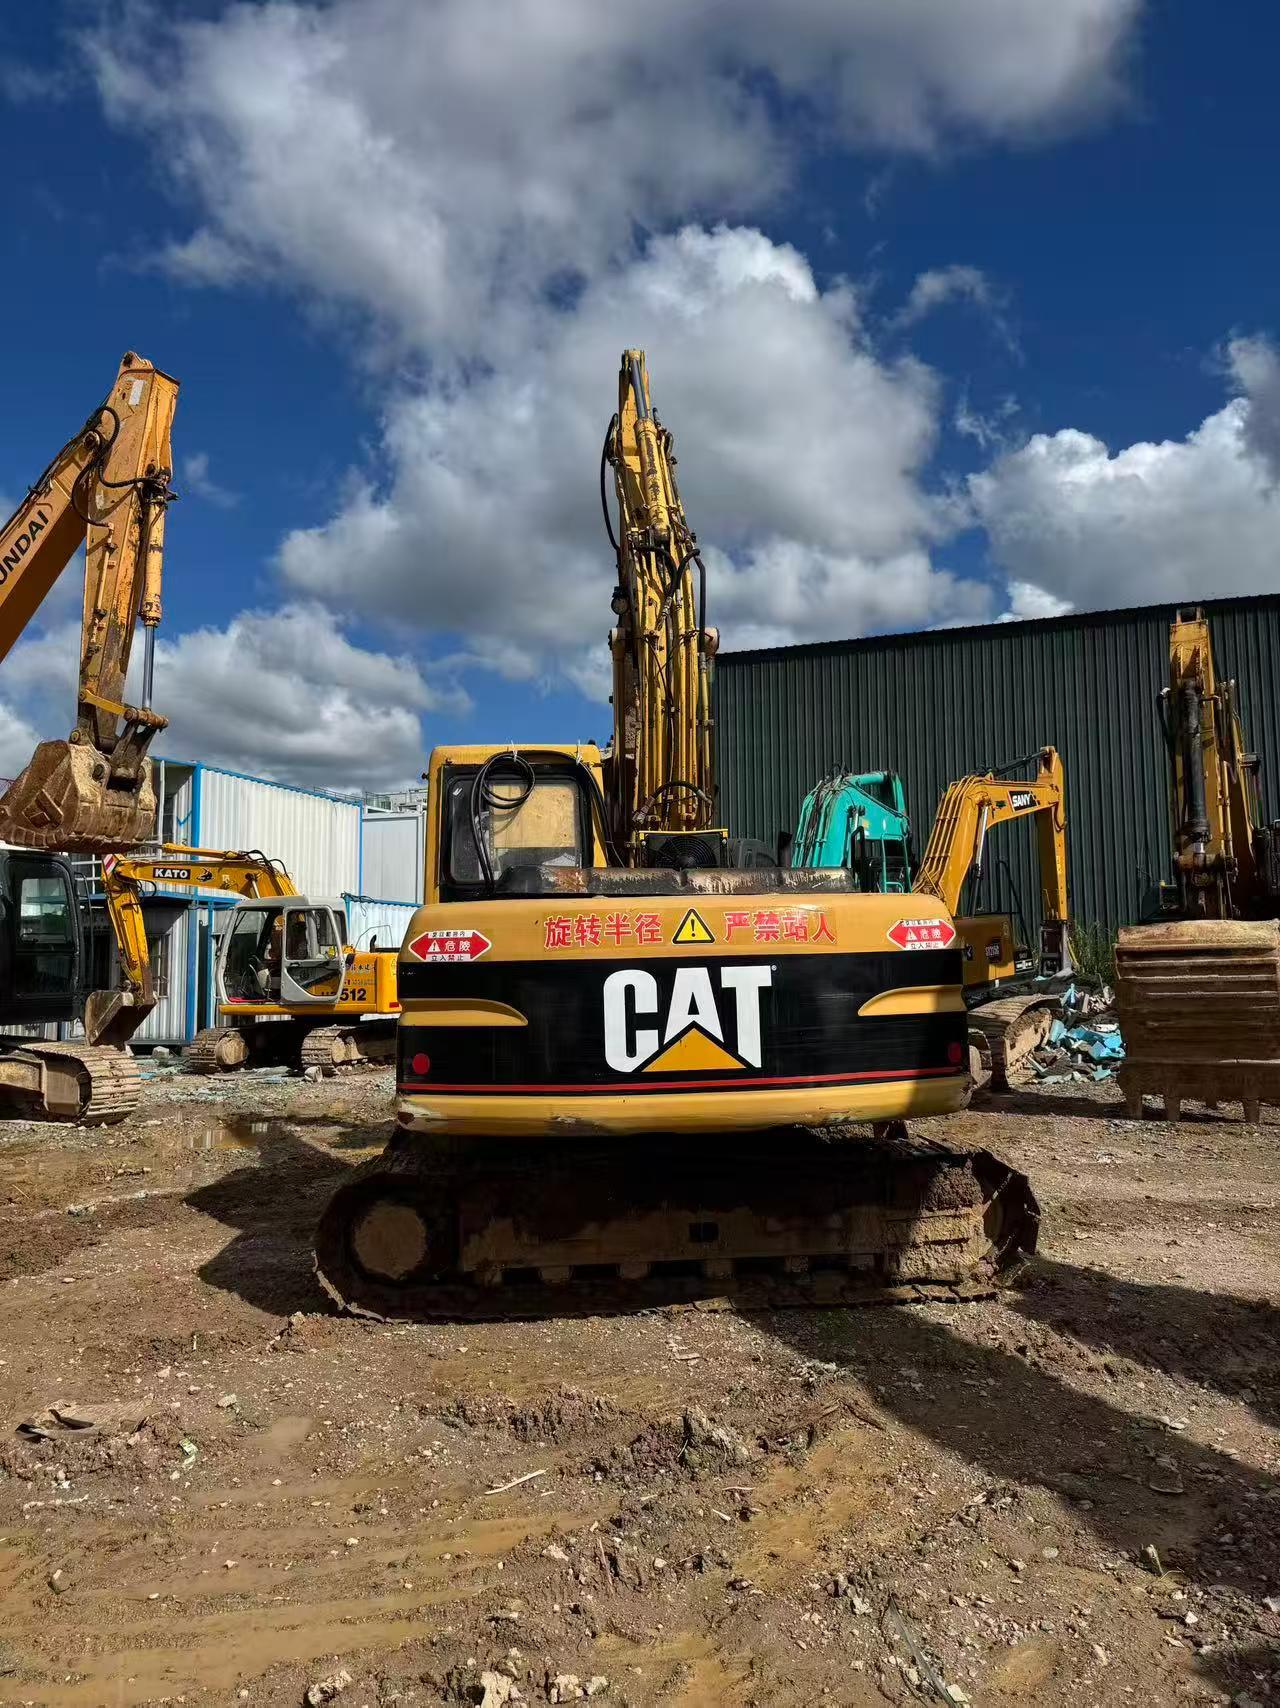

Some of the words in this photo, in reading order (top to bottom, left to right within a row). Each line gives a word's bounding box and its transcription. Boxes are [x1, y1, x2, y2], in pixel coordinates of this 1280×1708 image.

[1012, 794, 1031, 807] SANY
[154, 869, 189, 878] KATO
[544, 912, 663, 949] 旋转半径
[723, 911, 837, 944] 严禁站人
[603, 965, 772, 1073] CAT
